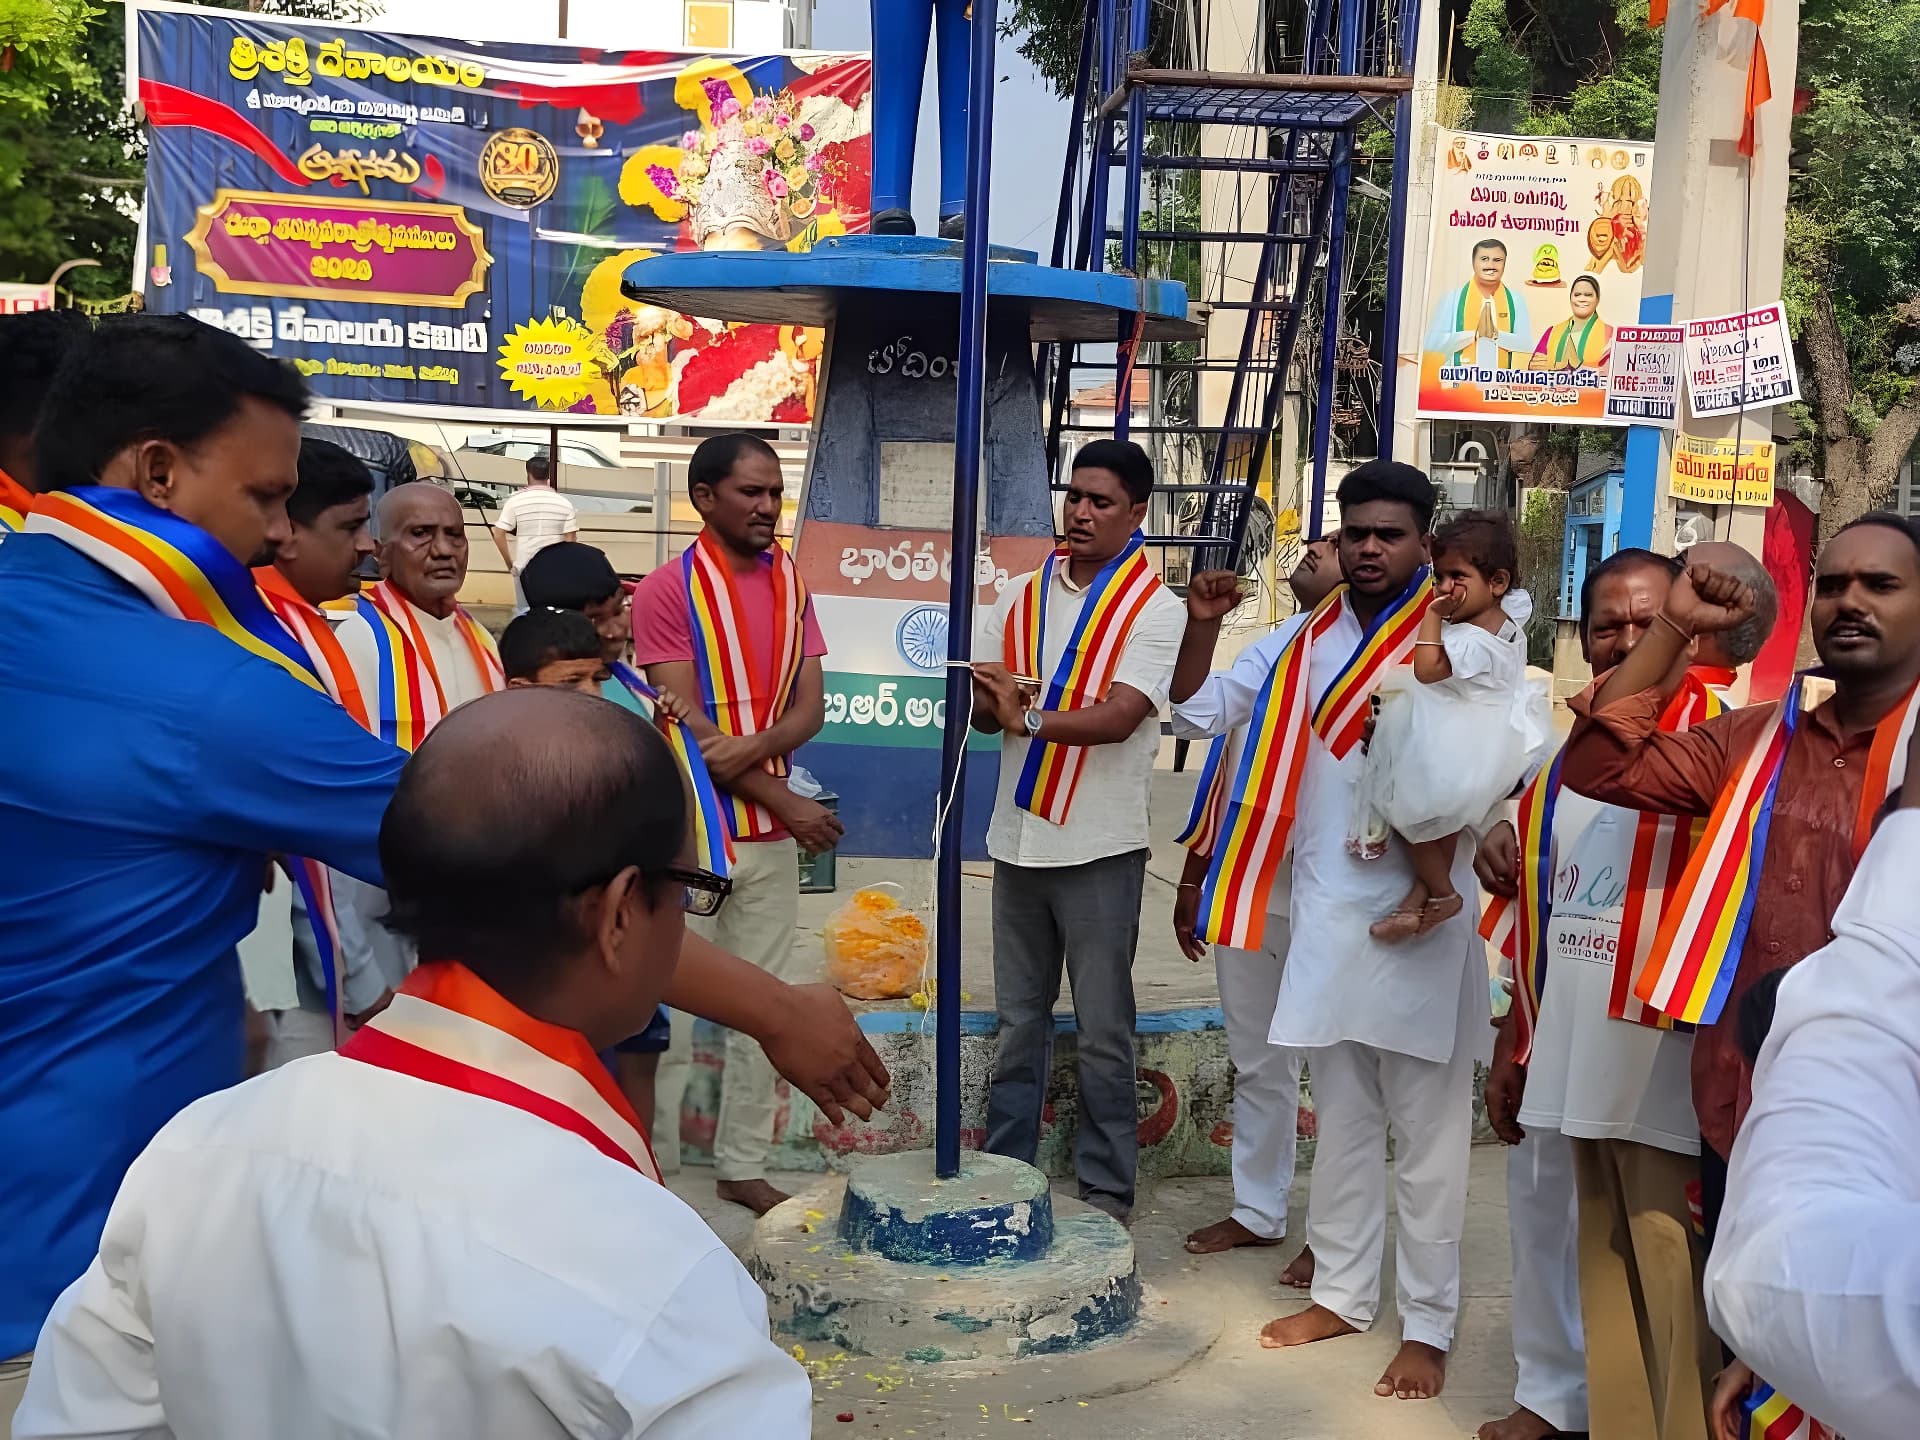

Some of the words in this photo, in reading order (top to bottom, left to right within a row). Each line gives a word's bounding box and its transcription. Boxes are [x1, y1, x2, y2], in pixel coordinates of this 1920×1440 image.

[316, 38, 486, 88] దేవాలయం
[278, 306, 404, 348] దేవాలయ
[823, 682, 947, 730] బి.ఆర్.అం
